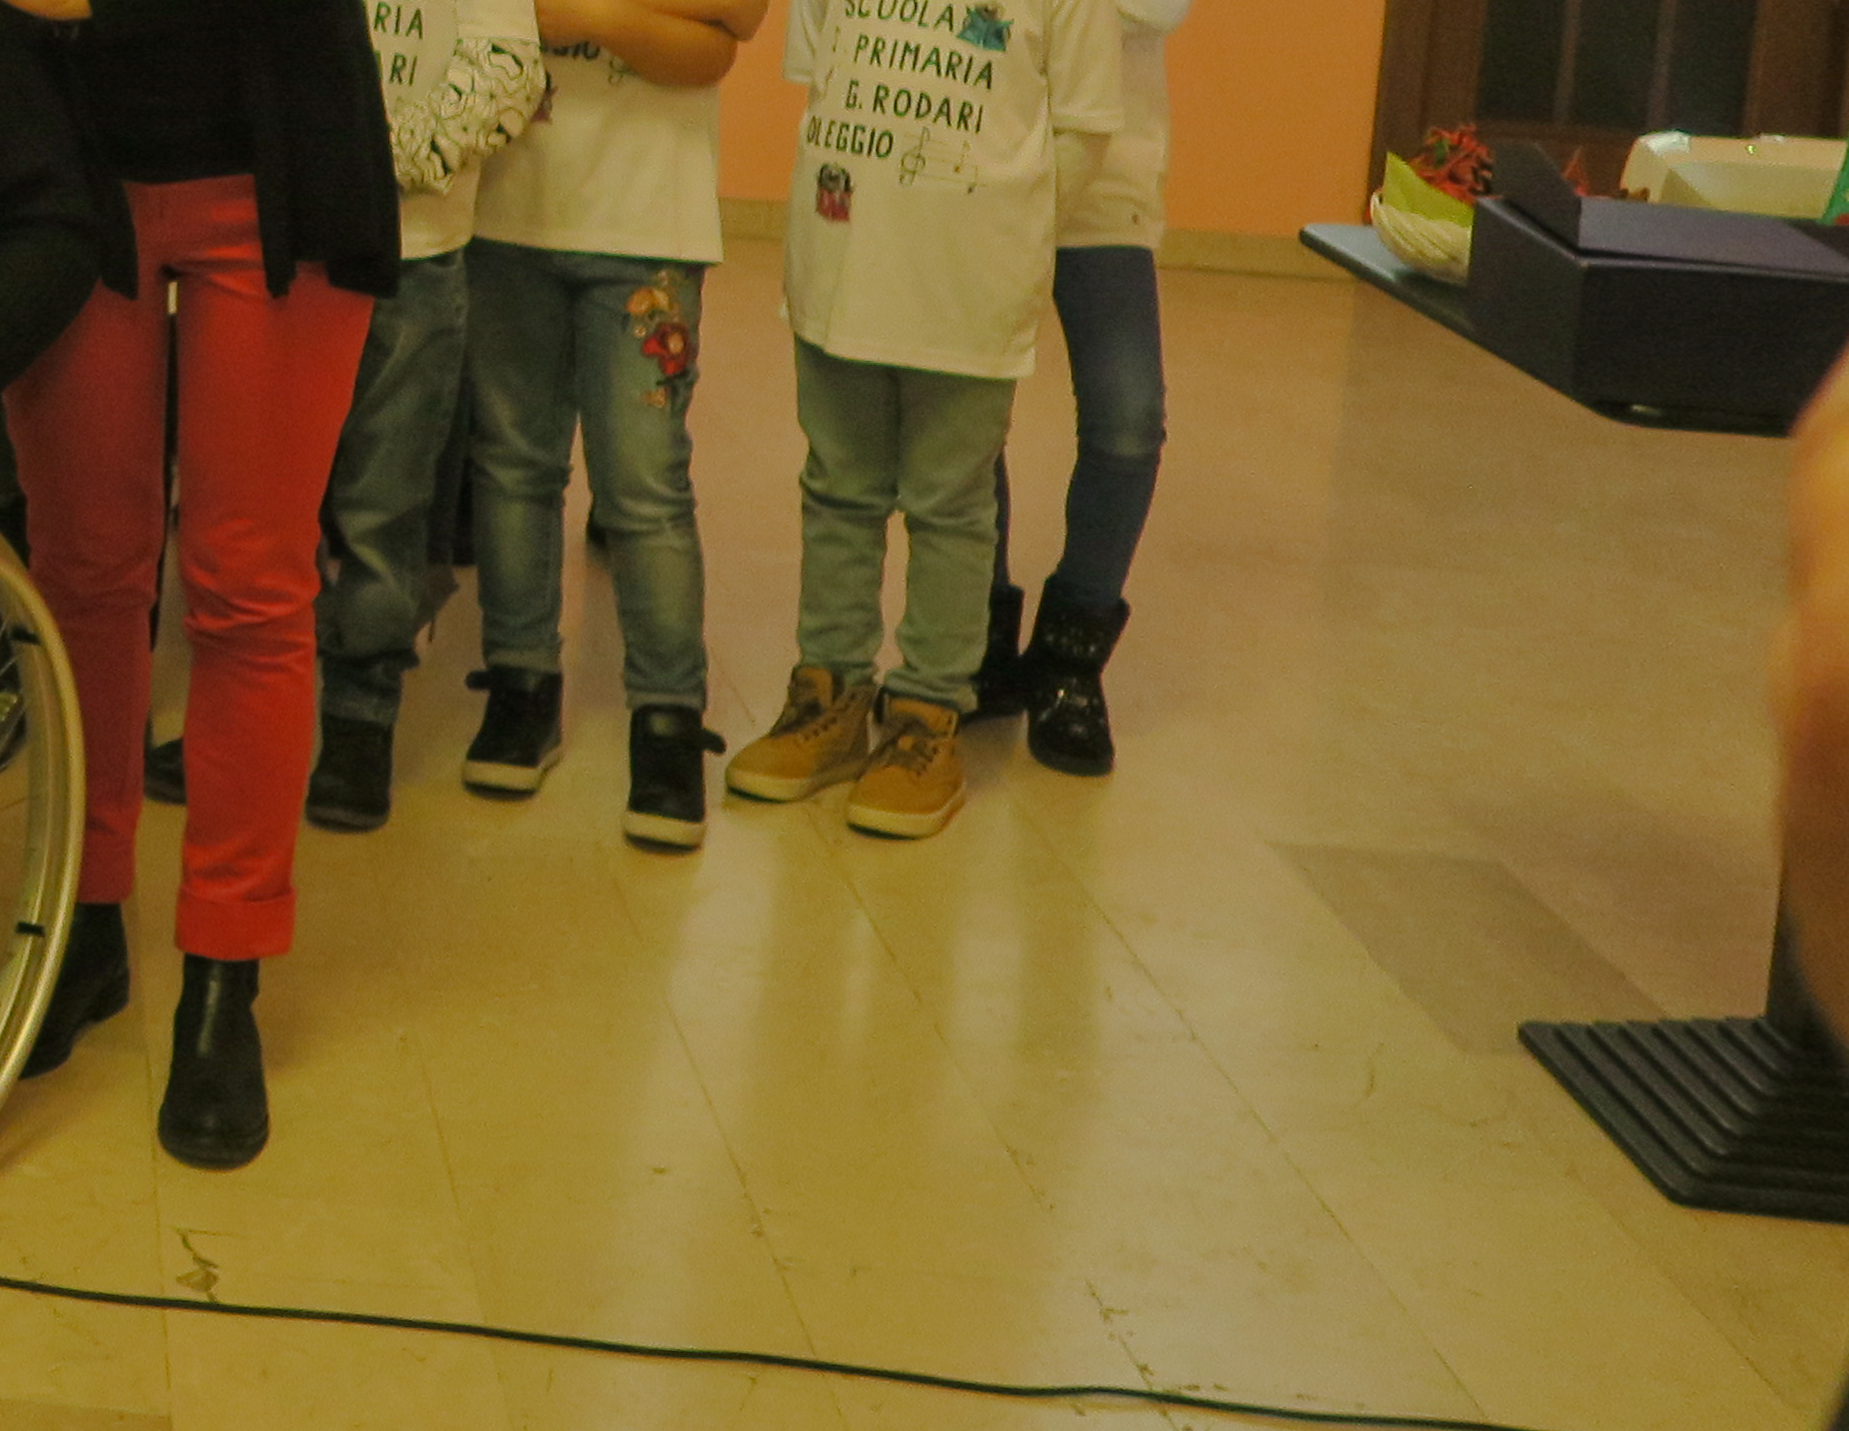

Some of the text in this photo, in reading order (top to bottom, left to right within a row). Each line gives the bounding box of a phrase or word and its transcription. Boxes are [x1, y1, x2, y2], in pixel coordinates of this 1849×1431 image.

[853, 33, 994, 91] PRIMARIA
[845, 79, 985, 135] G. RODARI
[807, 114, 895, 160] OLEGGIO
